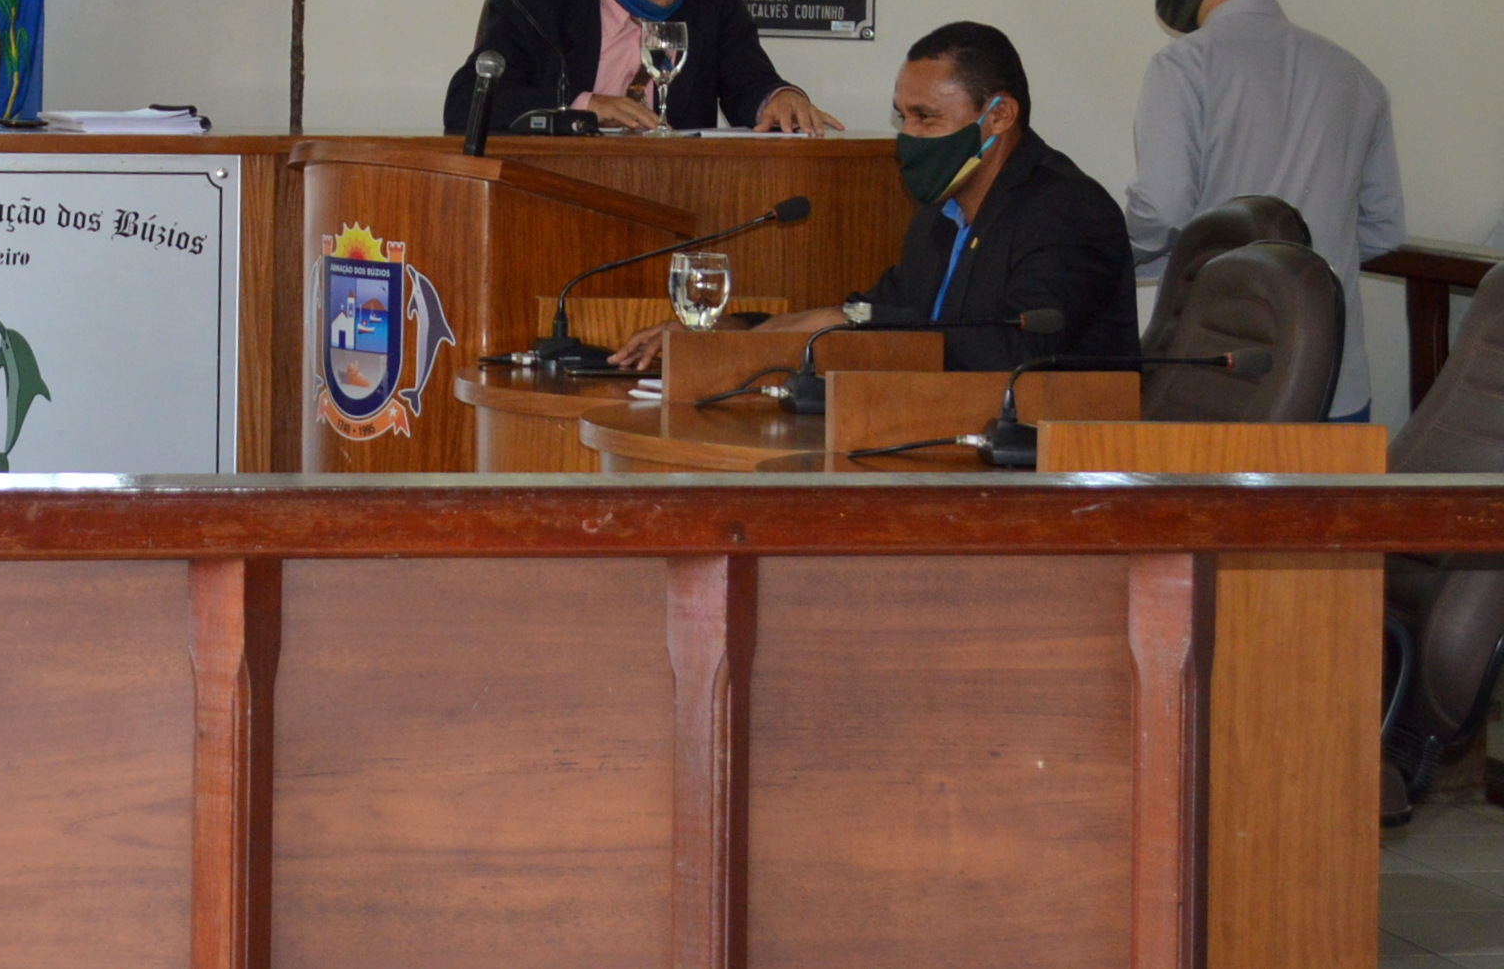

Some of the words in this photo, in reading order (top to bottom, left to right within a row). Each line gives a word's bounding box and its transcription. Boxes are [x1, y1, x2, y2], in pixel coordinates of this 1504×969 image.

[795, 5, 844, 20] COUTINHO
[57, 203, 103, 232] dos
[111, 208, 208, 256] Búzios
[354, 266, 366, 275] DOS
[367, 267, 390, 278] BÚZIOS
